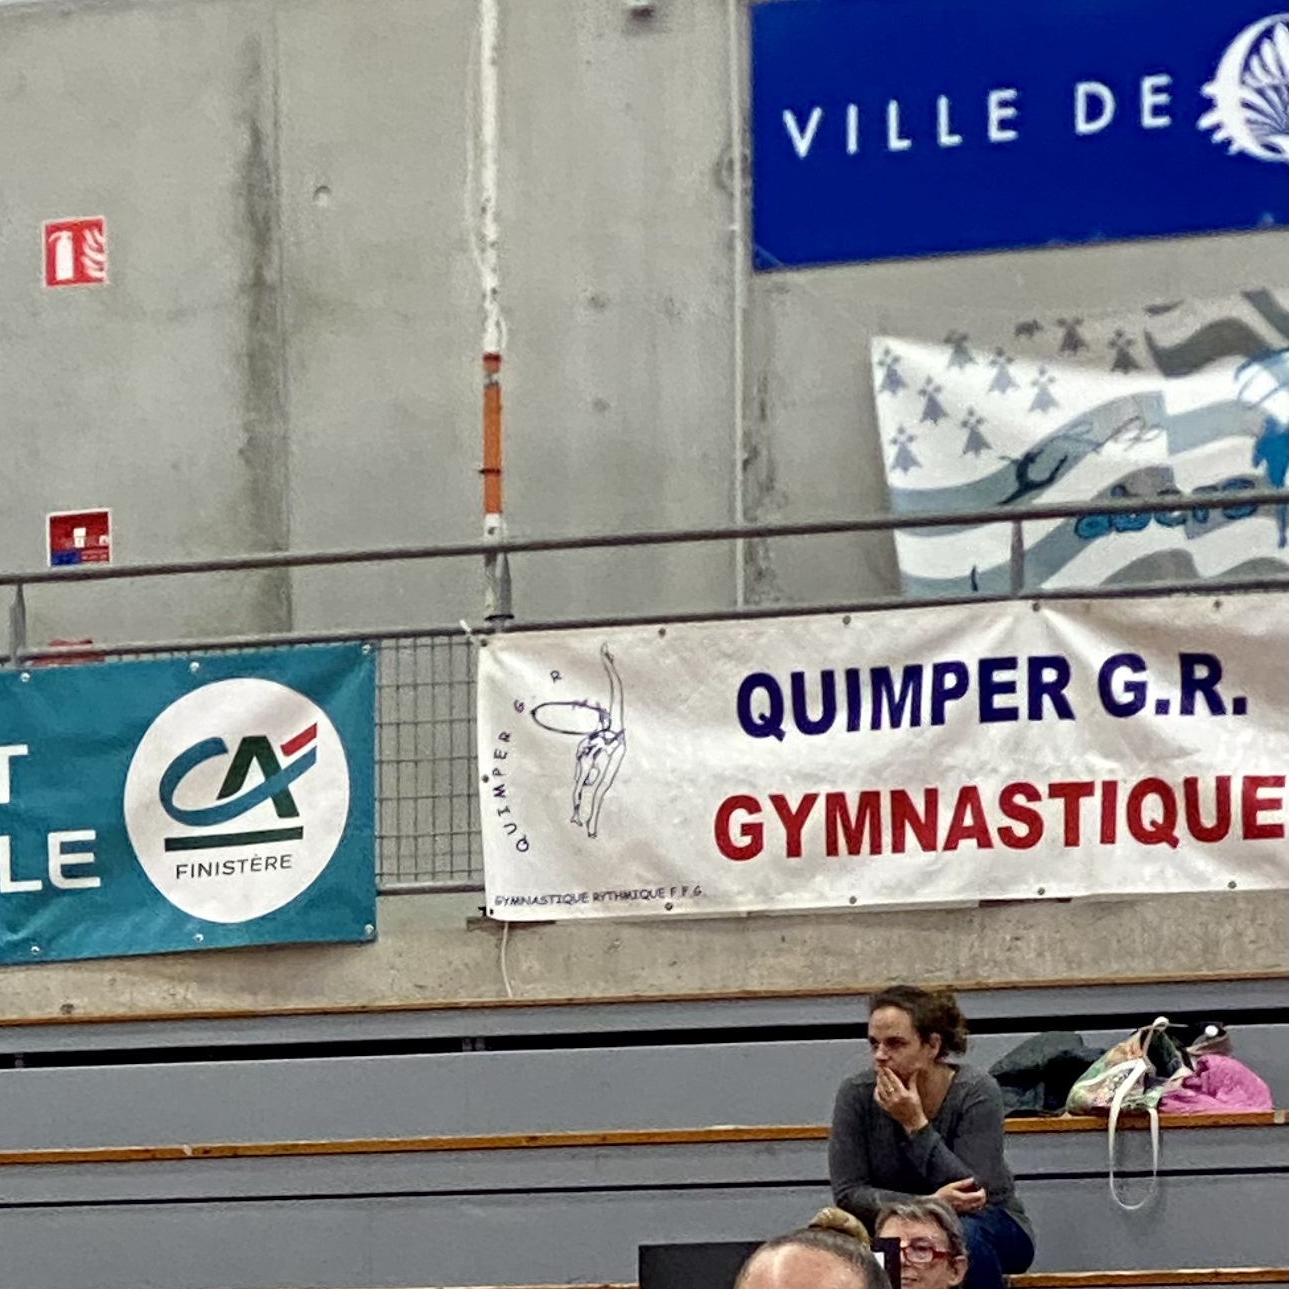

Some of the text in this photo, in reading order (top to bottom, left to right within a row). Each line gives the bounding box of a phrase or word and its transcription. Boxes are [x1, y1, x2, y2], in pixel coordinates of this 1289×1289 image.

[782, 73, 1173, 160] VILLE DE
[736, 652, 1248, 741] QUIMPER G.R.
[492, 729, 531, 854] QUIMPER
[714, 774, 1287, 862] GYMNASTIQUE
[175, 854, 293, 880] FINISTÈRE
[494, 890, 590, 908] GYMNASTIQUE
